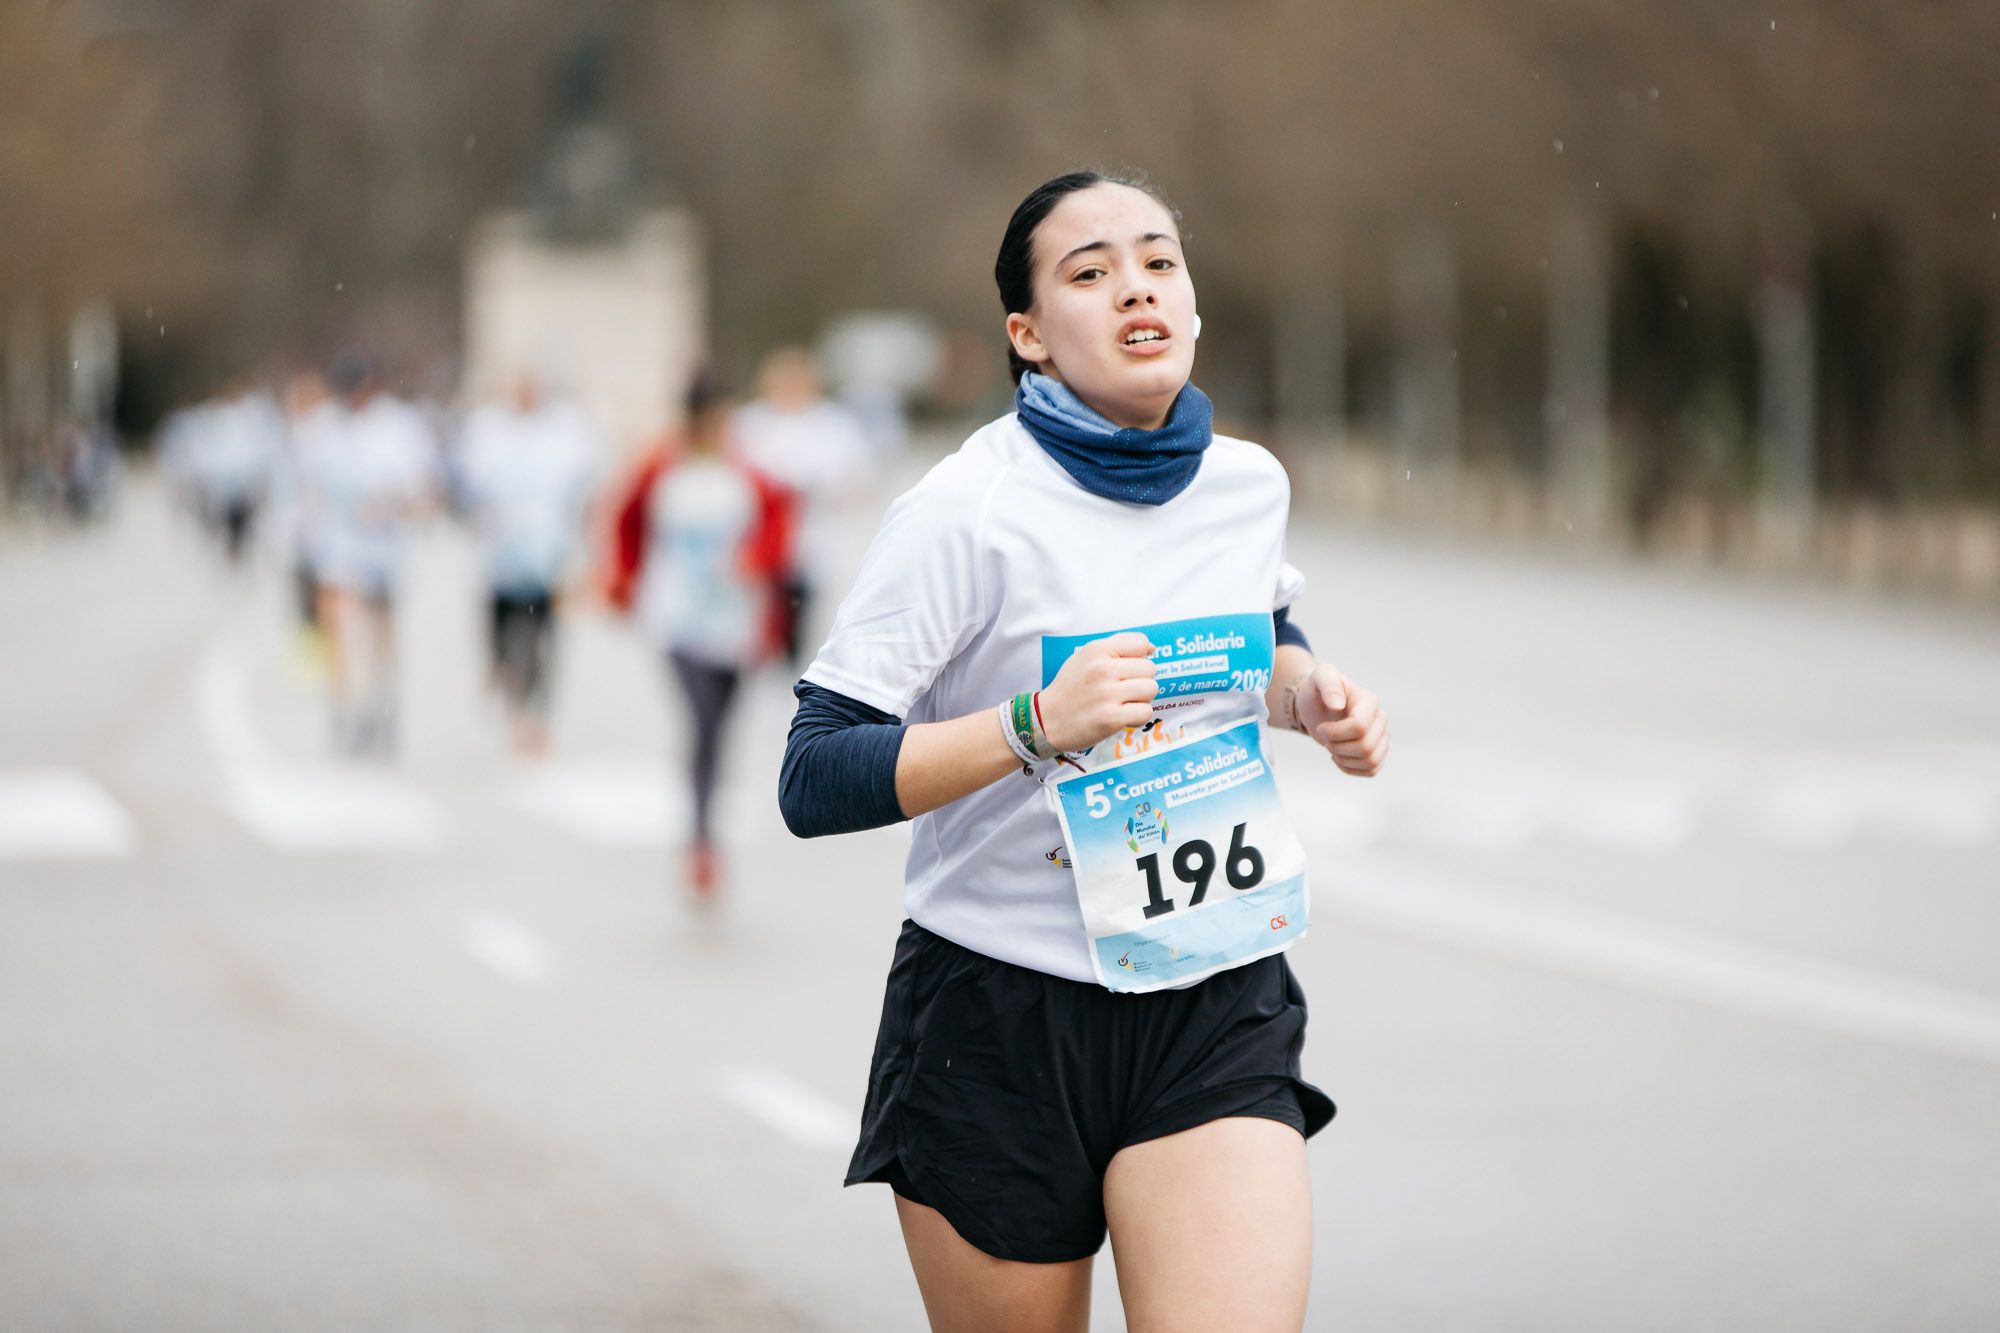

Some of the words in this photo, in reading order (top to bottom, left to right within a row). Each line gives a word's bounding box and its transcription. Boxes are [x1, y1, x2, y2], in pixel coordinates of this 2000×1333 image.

[1176, 631, 1246, 656] Solidaria
[1169, 682, 1177, 693] 7
[1178, 681, 1192, 692] de
[1194, 679, 1229, 690] marzo
[1230, 668, 1270, 692] 2026
[1114, 772, 1183, 801] Carrera
[1184, 746, 1249, 780] Solidaria
[1136, 822, 1266, 920] 196
